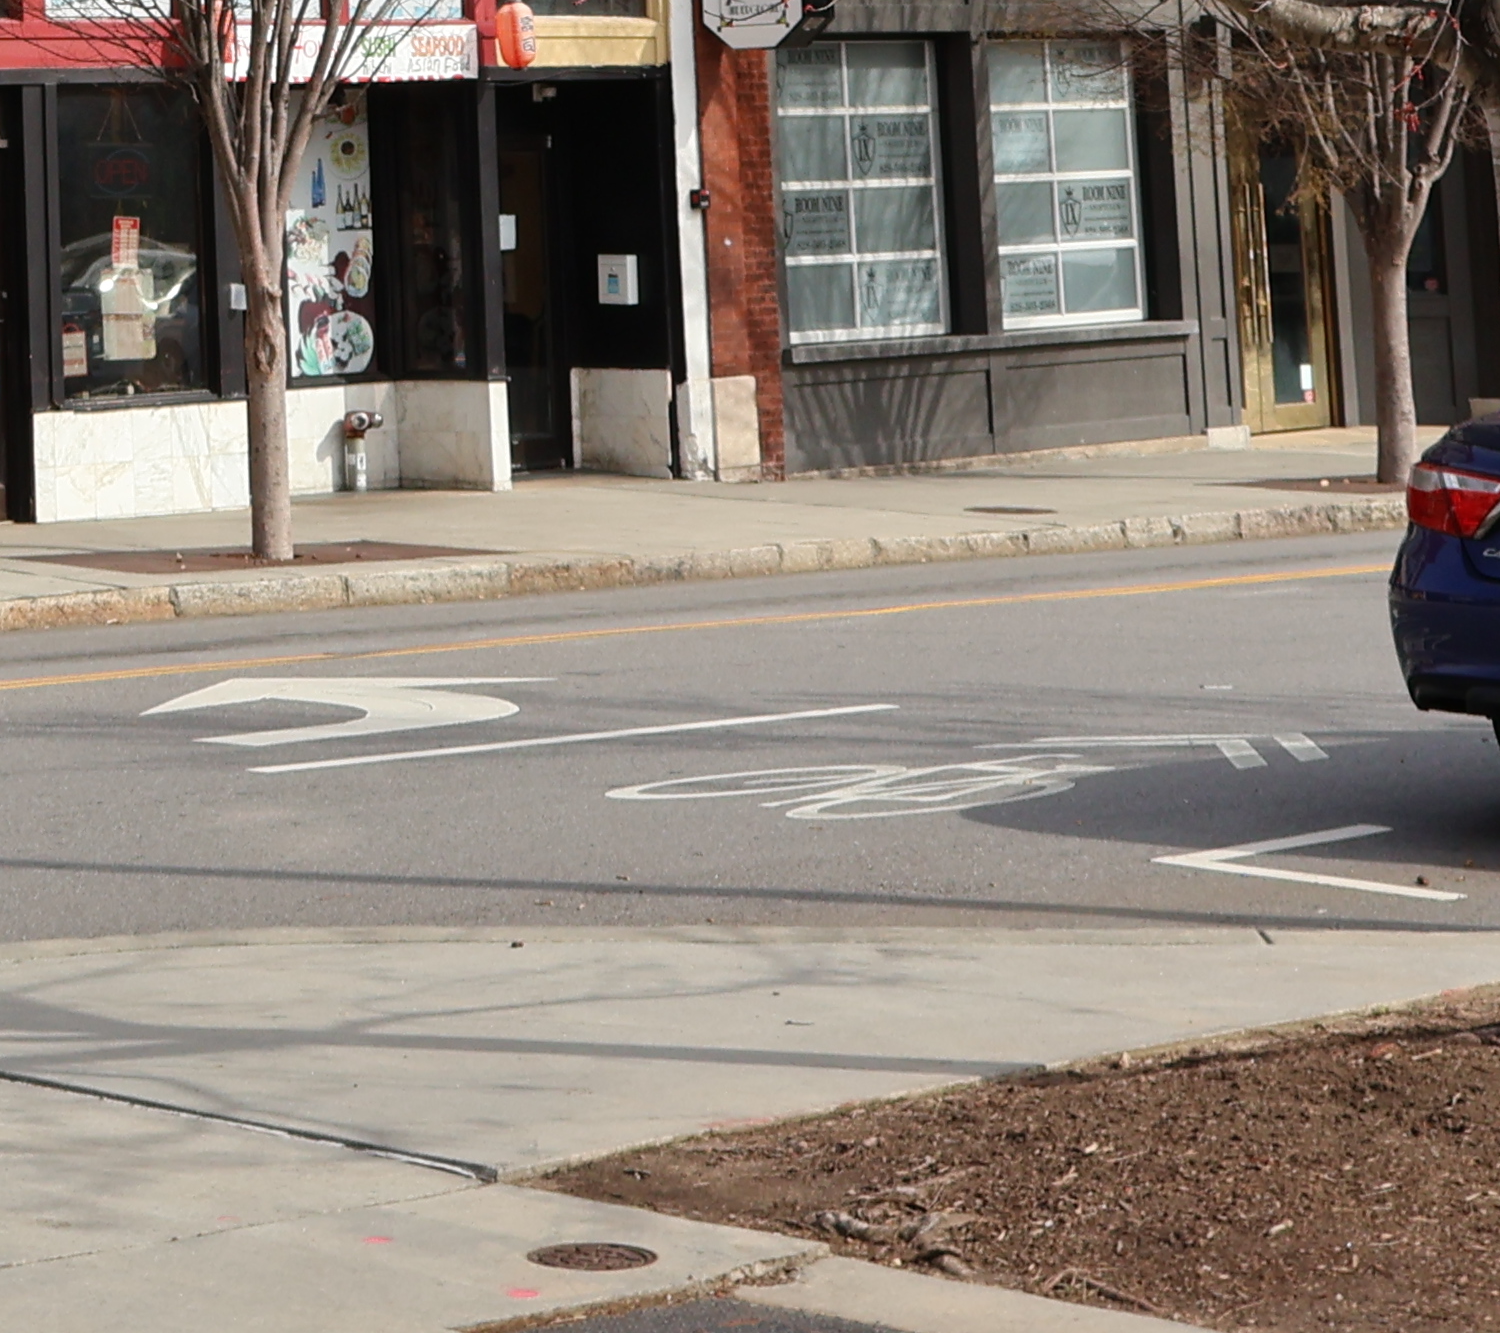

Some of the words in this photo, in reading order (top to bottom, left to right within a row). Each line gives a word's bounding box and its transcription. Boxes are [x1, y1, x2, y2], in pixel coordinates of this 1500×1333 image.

[411, 35, 465, 57] SEAFOOD
[94, 160, 148, 185] OPEN
[1082, 186, 1105, 201] ROOM
[1105, 185, 1126, 200] NINE
[795, 197, 820, 214] ROOM
[820, 195, 844, 212] NINE
